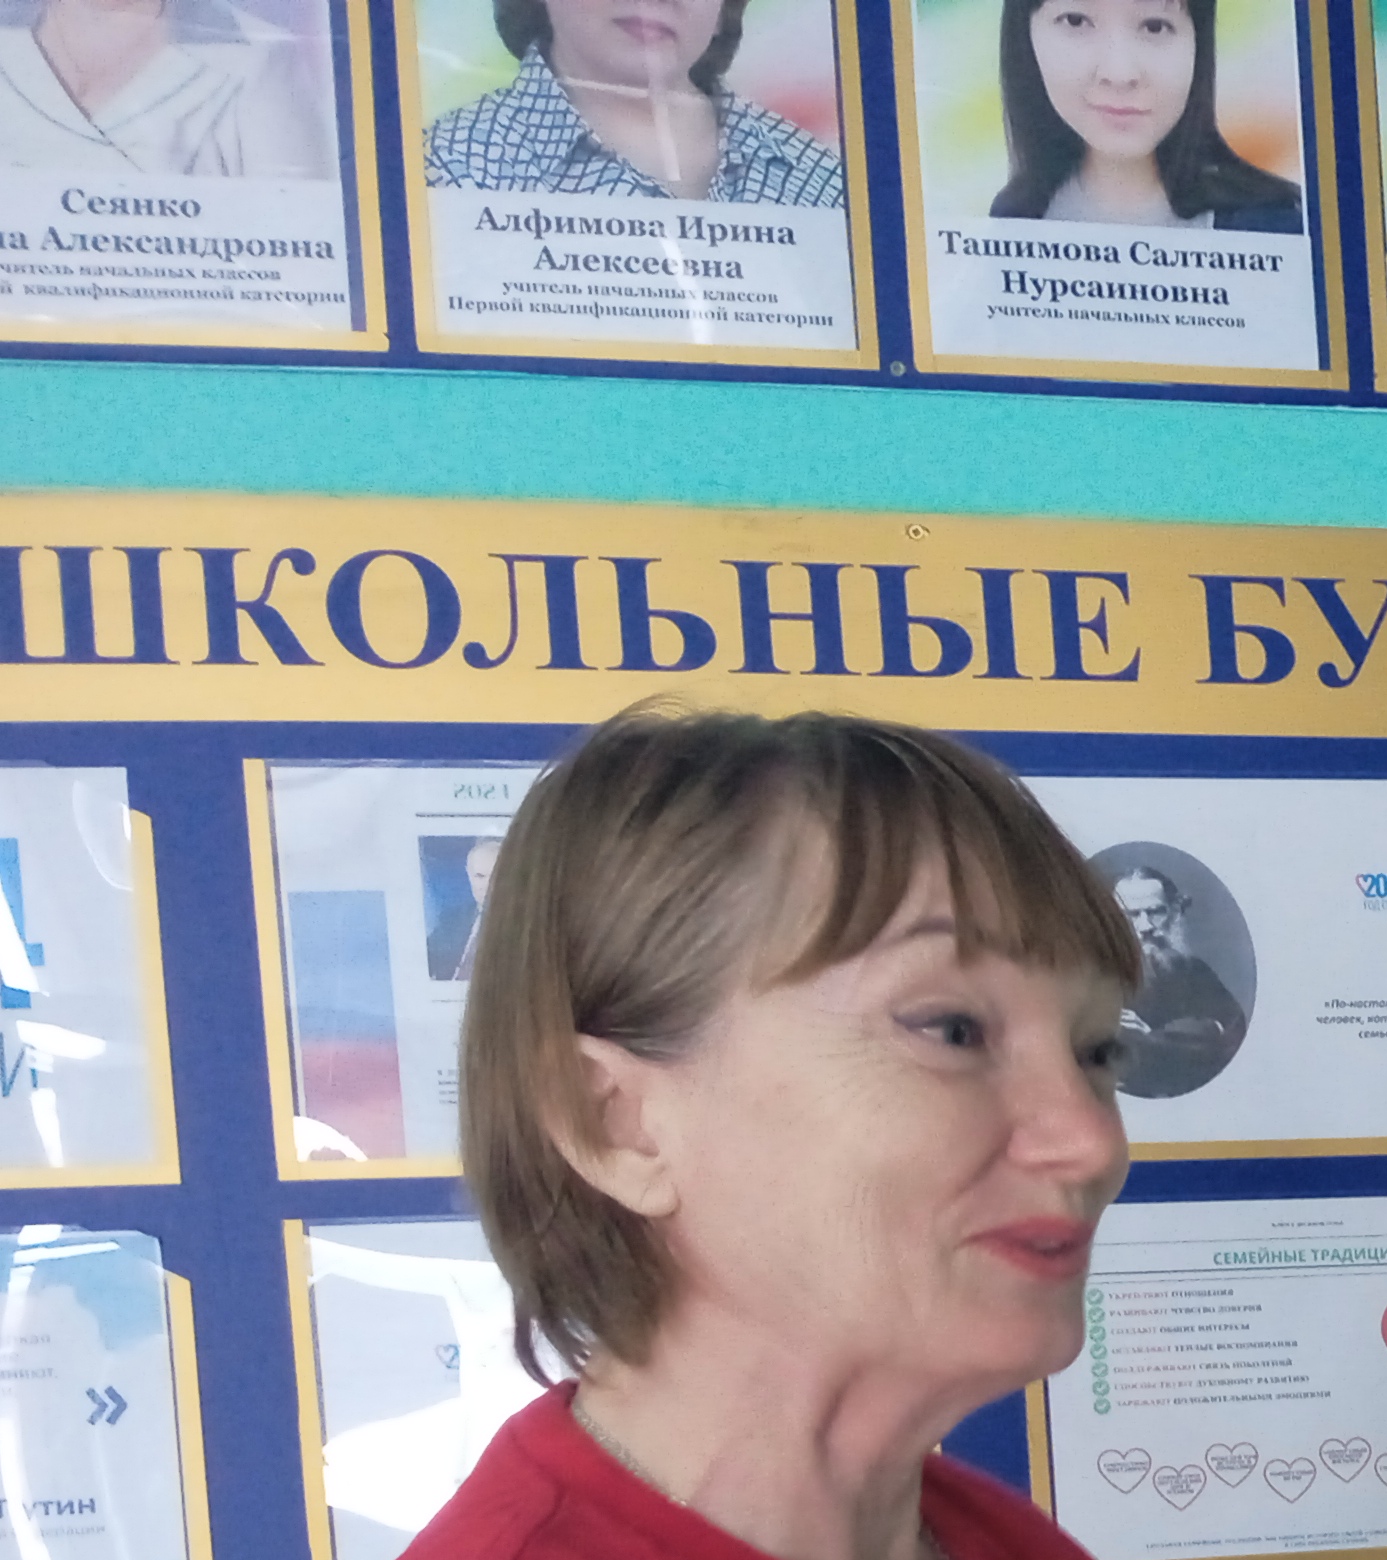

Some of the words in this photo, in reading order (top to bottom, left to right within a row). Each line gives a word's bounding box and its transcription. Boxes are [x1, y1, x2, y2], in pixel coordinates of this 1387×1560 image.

[60, 189, 201, 218] Сеянко
[475, 207, 666, 239] Алфимова
[676, 215, 796, 246] Ирина
[41, 226, 334, 262] Александровна
[939, 230, 1120, 263] Ташимова
[1130, 241, 1283, 272] Салтанат
[79, 265, 196, 279] начальных
[202, 269, 280, 280] классов
[534, 245, 743, 279] Алексеевна
[24, 283, 234, 301] квалификационной
[240, 289, 345, 304] категории
[503, 280, 582, 294] учитель
[588, 283, 698, 299] начальных
[703, 289, 778, 303] классов
[1001, 270, 1229, 305] Нурсаиновна
[449, 296, 523, 313] Первой
[530, 300, 728, 321] квалификационной
[734, 309, 833, 326] категории
[987, 304, 1063, 319] учитель
[1068, 308, 1170, 325] начальных
[1175, 315, 1245, 328] классов
[0, 545, 1141, 683] ШКОЛЬНЫЕ
[1213, 1246, 1306, 1266] СЕМЕЙНЫЕ
